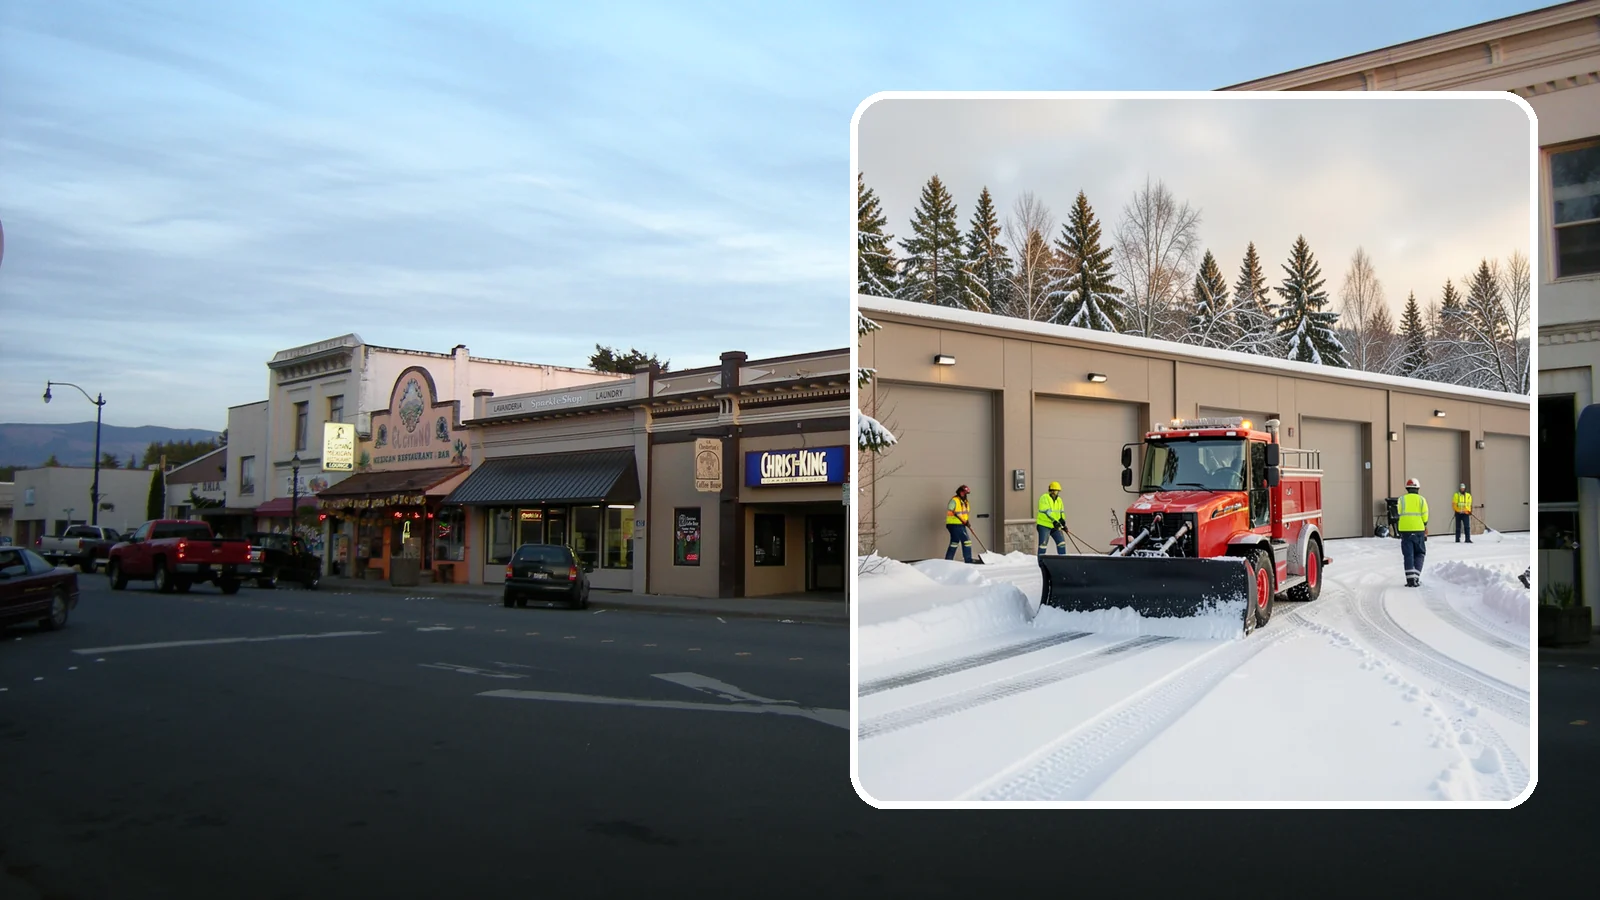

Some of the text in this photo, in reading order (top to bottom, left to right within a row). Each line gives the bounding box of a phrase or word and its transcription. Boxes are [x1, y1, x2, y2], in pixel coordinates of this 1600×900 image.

[595, 389, 623, 399] LAUNDRY
[493, 402, 522, 413] LAVANDERIA
[531, 394, 582, 409] Sparkle Shop
[373, 454, 396, 464] MEXICAN
[397, 451, 433, 462] RESTAURANT
[437, 450, 450, 458] BAR
[761, 450, 827, 478] CHRIST KING
